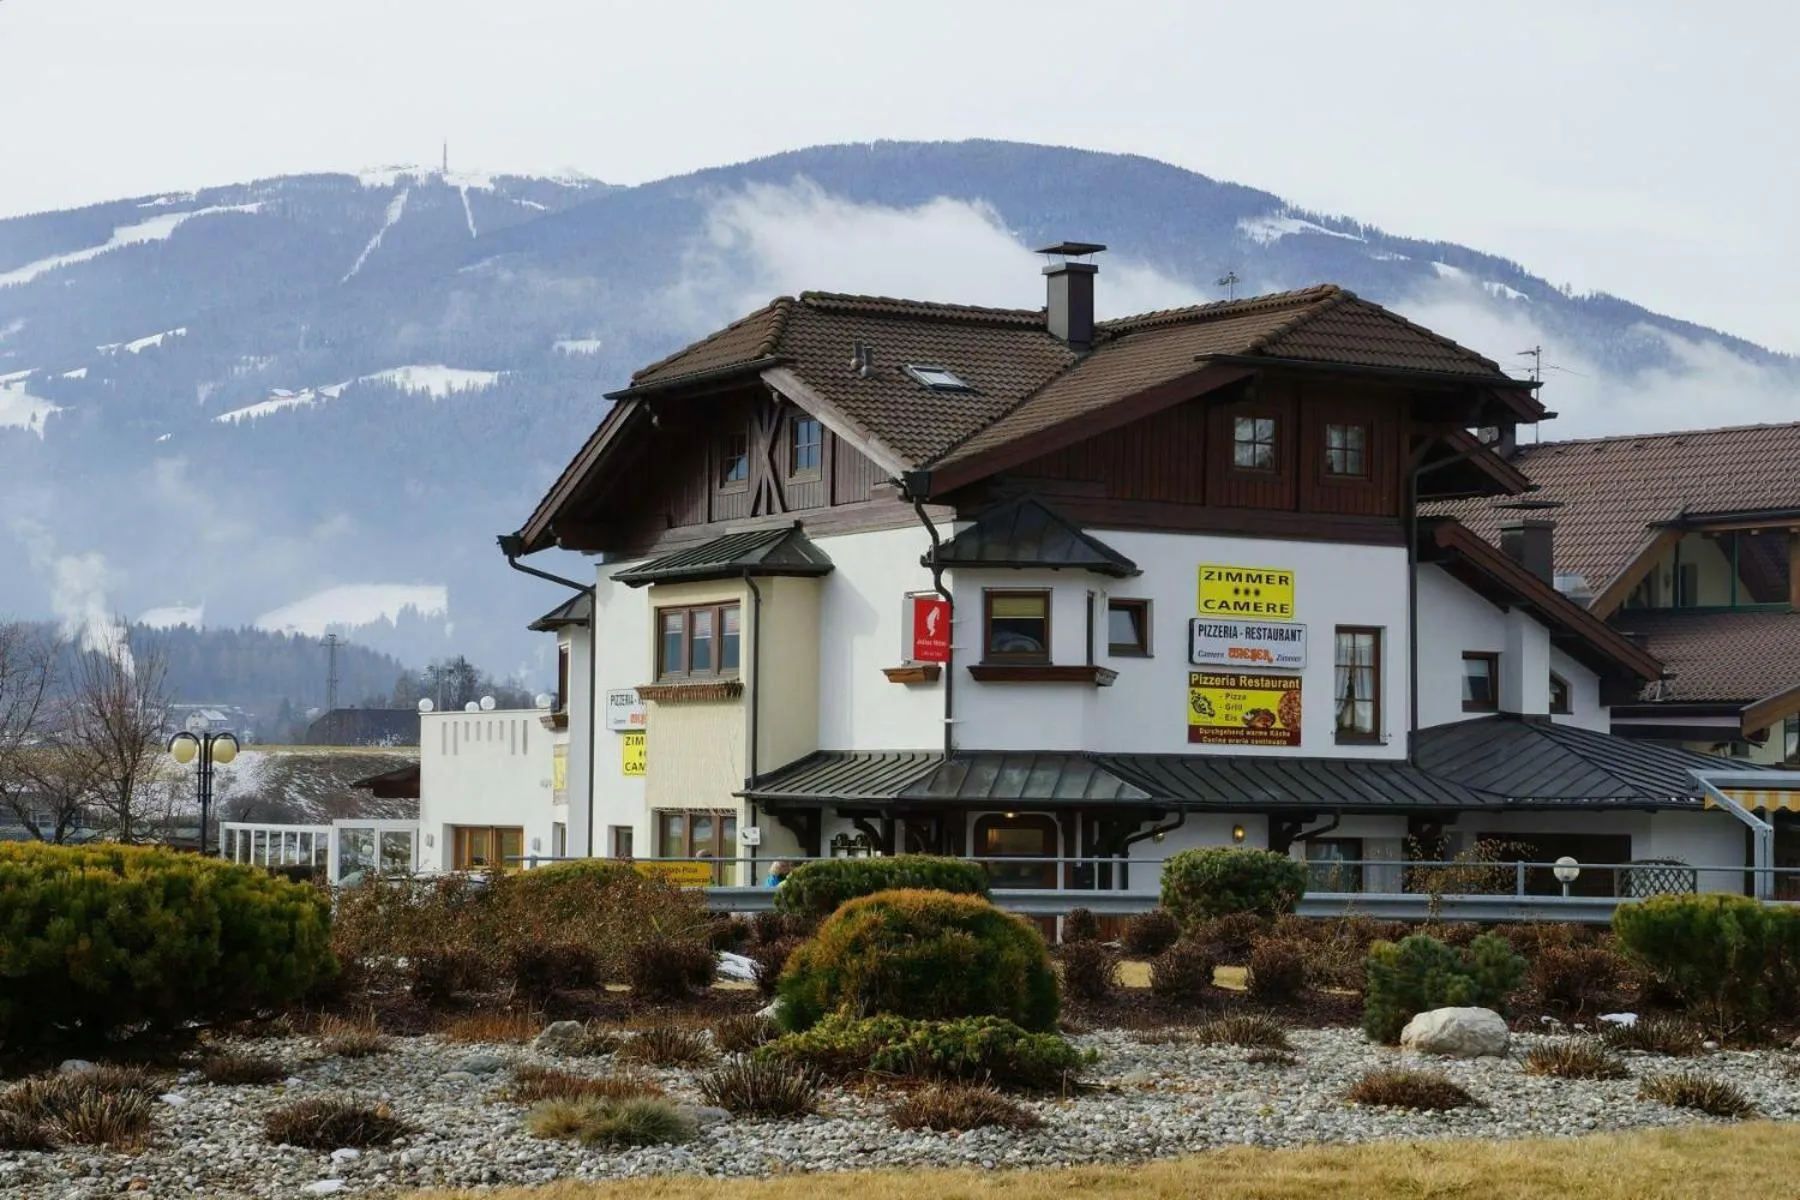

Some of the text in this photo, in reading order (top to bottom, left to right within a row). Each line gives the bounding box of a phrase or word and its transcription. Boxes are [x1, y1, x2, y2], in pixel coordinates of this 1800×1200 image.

[1204, 570, 1289, 586] ZIMMER
[1203, 599, 1290, 614] CAMERE
[1198, 623, 1303, 642] PIZZERIA RESTAURANT
[1191, 673, 1300, 690] Pizzeria Restaurant
[1224, 692, 1247, 701] Pizza
[1224, 703, 1243, 712] Grill
